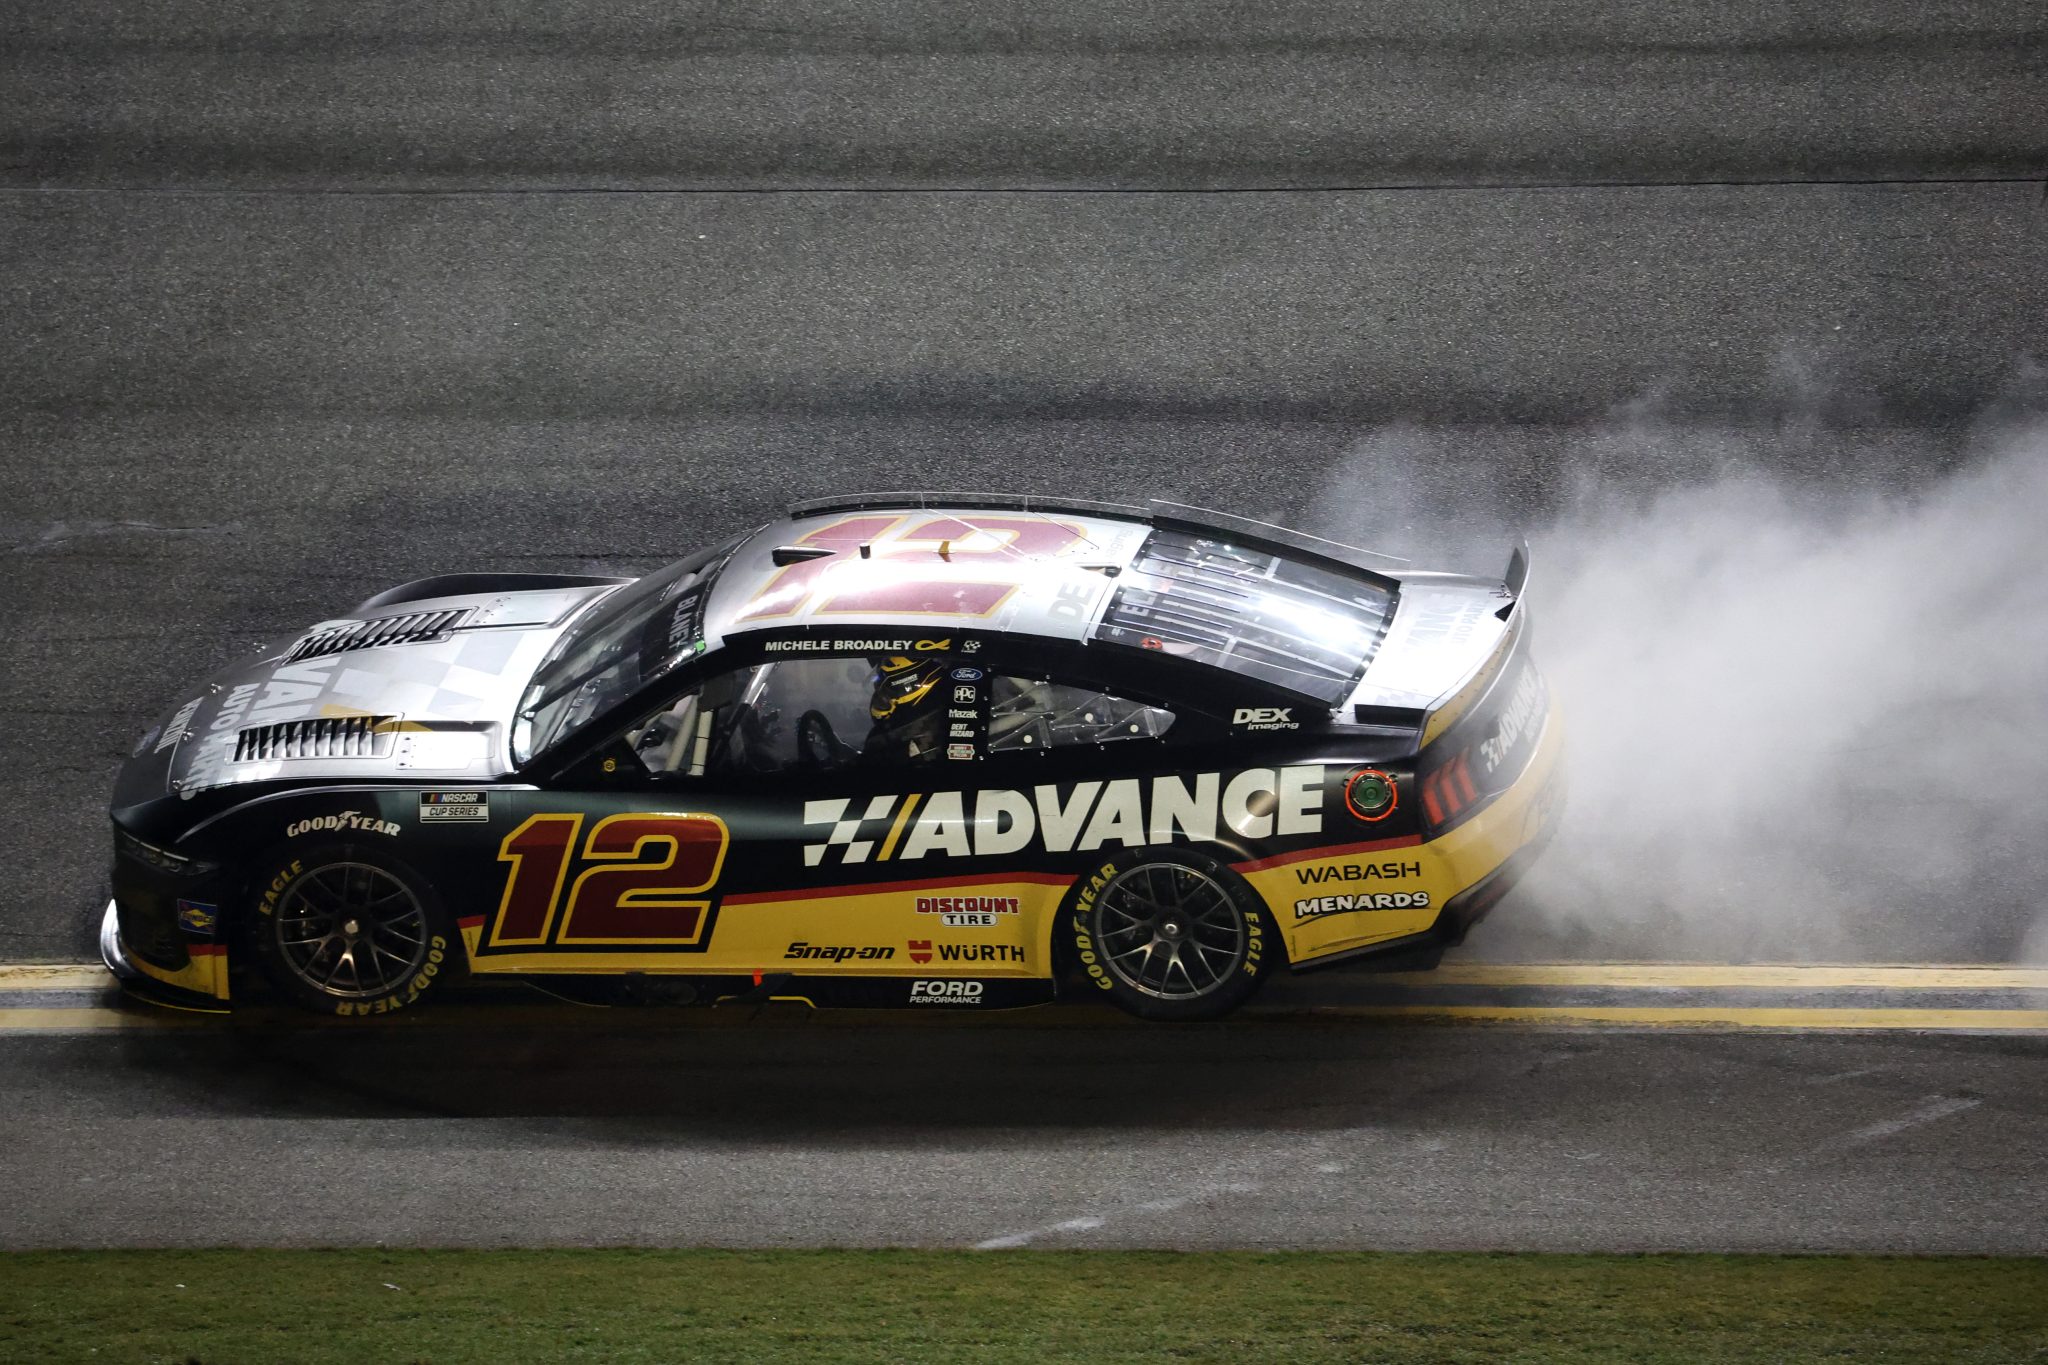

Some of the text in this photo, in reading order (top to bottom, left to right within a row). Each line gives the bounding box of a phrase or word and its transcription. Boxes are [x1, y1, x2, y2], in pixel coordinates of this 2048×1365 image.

[669, 594, 698, 650] BLANEY
[765, 639, 912, 652] MICHELE BROADLEY
[955, 669, 977, 679] Ford
[955, 687, 974, 701] PPG
[209, 682, 262, 730] AUTO
[948, 709, 978, 719] Mazak
[1232, 708, 1294, 724] DEX
[949, 730, 975, 738] WIZARD
[951, 723, 968, 731] DENT
[1247, 722, 1299, 731] imaging
[441, 793, 478, 803] NASCAR
[429, 807, 479, 816] CUP SERIES
[898, 764, 1326, 860] ADVANCE
[488, 812, 730, 948] 12
[1296, 861, 1421, 885] WABASH
[258, 860, 303, 916] EAGLE
[916, 897, 1020, 915] DISCOUNT
[1295, 890, 1430, 919] MENARDS
[946, 914, 991, 925] TIRE
[1243, 912, 1263, 977] EAGLE
[784, 942, 896, 963] Snap-on
[938, 945, 1026, 963] WÜRTH
[911, 981, 984, 996] FORD
[909, 996, 982, 1004] PERFORMANCE
